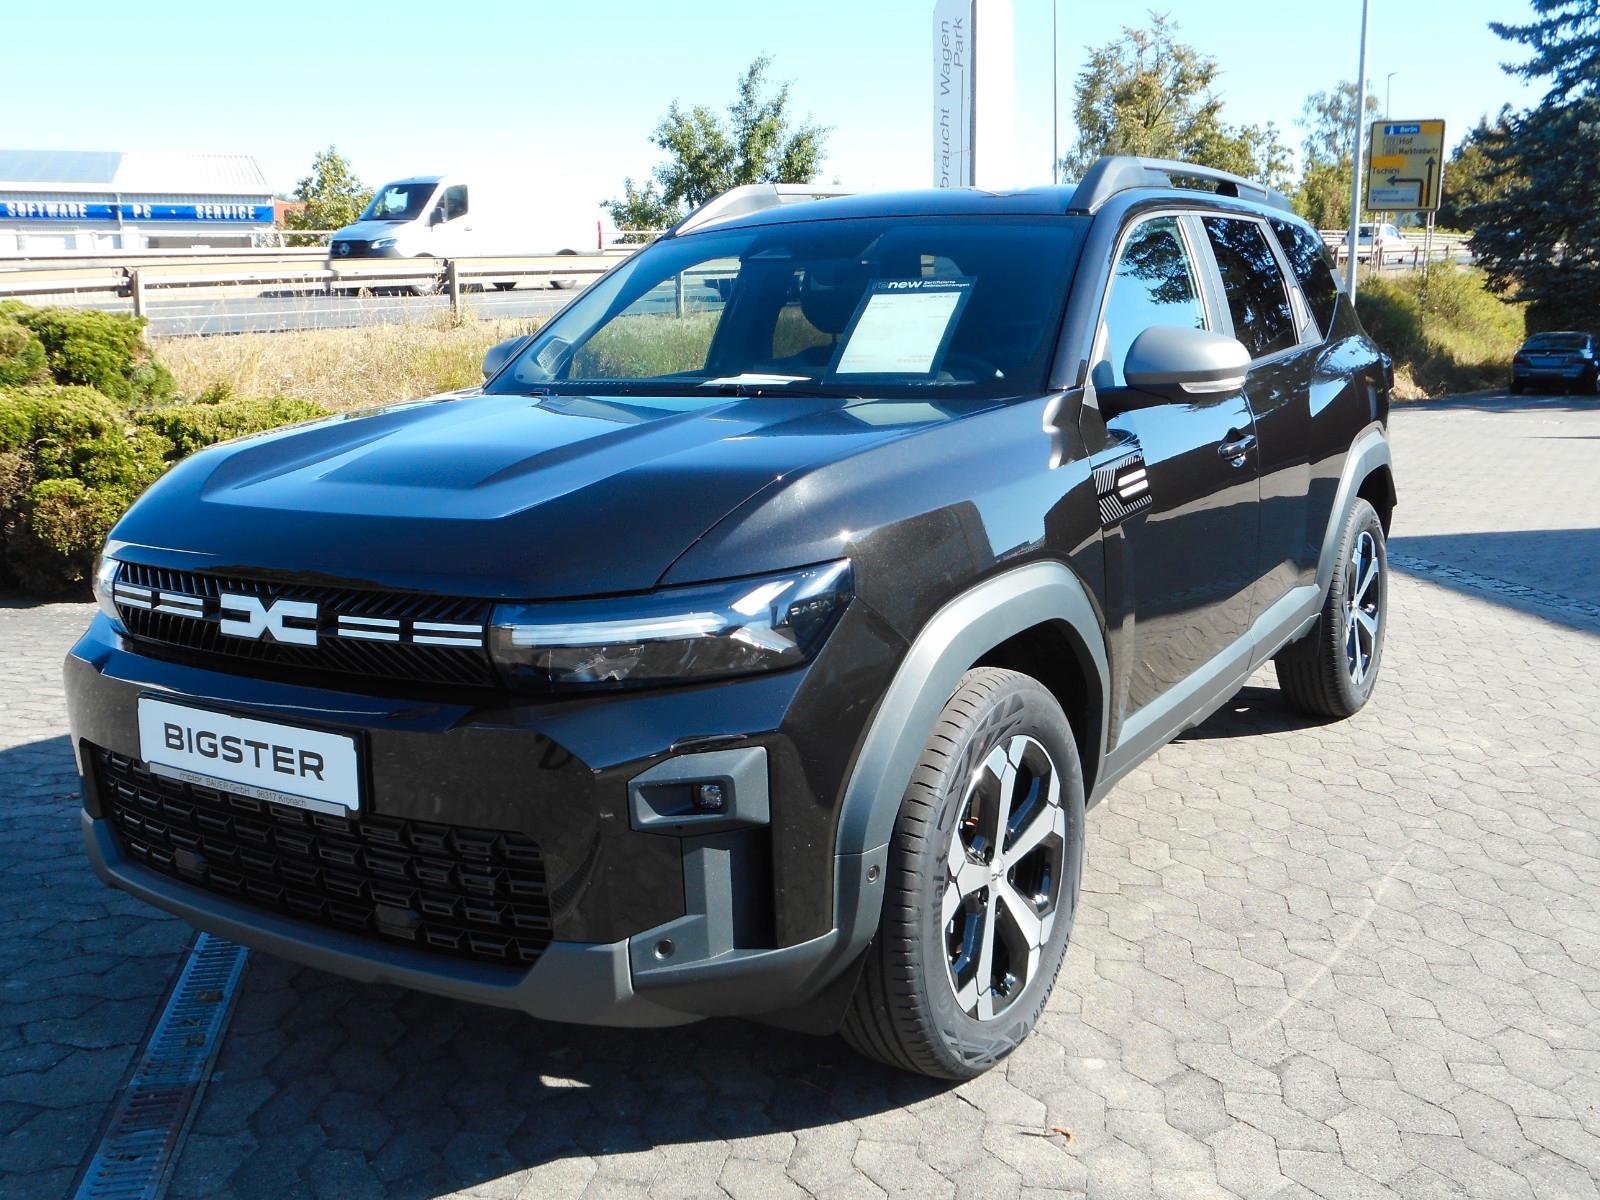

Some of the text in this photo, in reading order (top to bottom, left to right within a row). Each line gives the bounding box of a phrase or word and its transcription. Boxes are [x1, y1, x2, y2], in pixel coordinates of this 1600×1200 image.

[940, 20, 952, 96] Wagen
[953, 17, 963, 67] Park
[6, 202, 87, 217] SOFTWARE
[195, 205, 255, 219] SERVICE
[164, 722, 325, 782] BIGSTER
